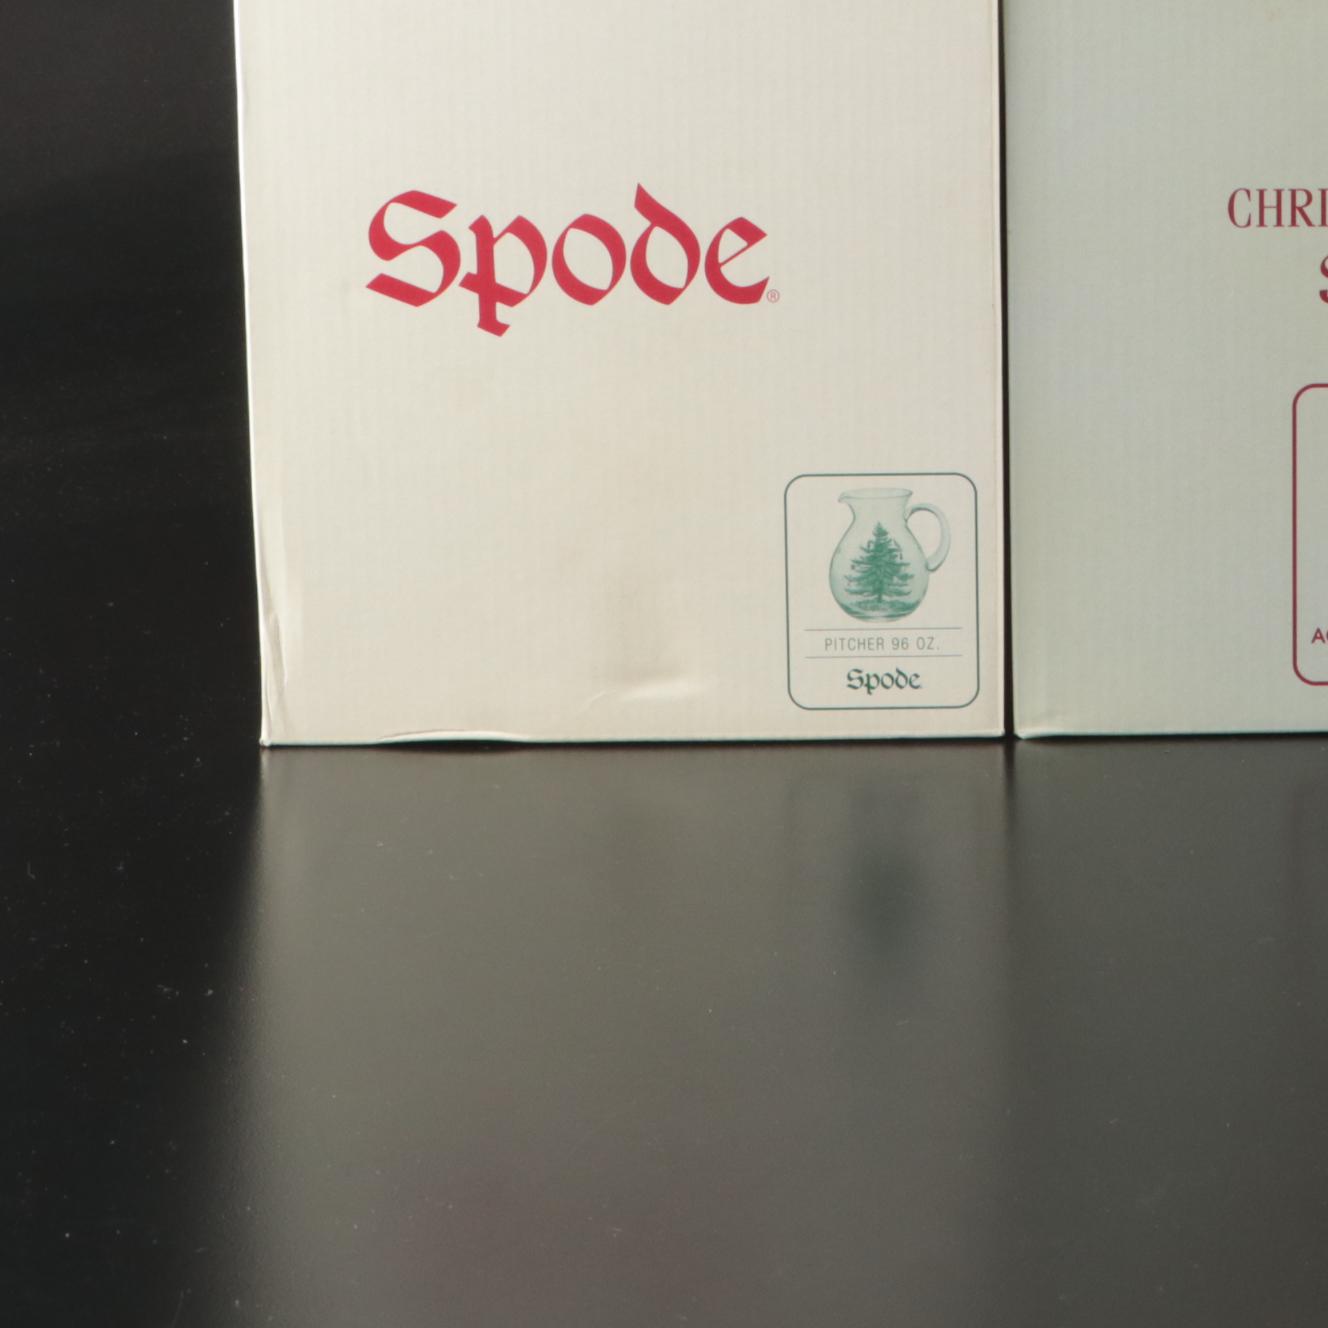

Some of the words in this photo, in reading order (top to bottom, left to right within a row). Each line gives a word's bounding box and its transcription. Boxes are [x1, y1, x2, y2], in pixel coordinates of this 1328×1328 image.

[824, 637, 885, 651] PITCHER
[892, 636, 909, 651] 96
[846, 667, 922, 696] Spode
